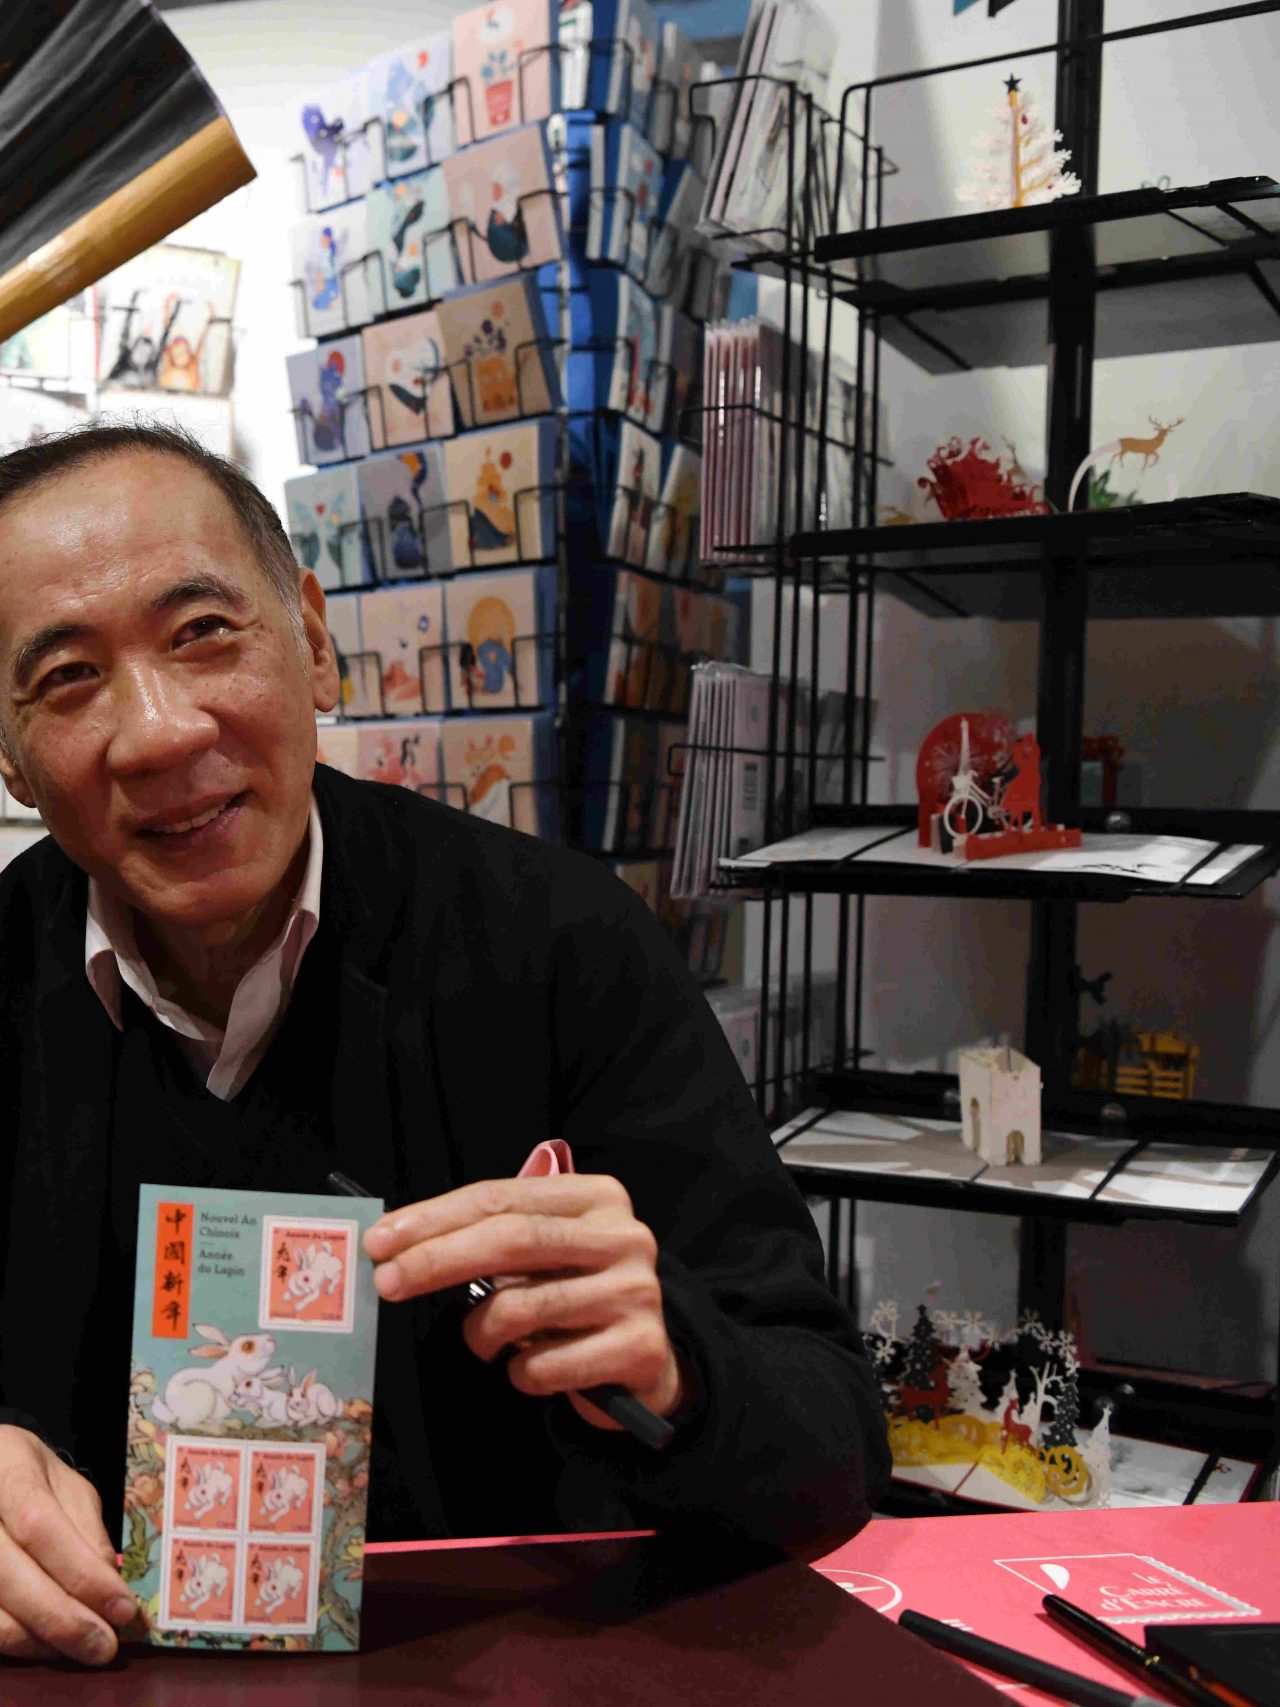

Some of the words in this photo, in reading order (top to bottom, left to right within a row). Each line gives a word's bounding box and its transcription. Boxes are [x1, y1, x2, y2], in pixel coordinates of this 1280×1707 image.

[200, 1212, 239, 1223] Nouvel
[241, 1214, 256, 1225] An
[199, 1226, 240, 1238] Chinois
[199, 1249, 233, 1260] Année
[197, 1264, 211, 1273] du
[214, 1264, 245, 1278] Lapin
